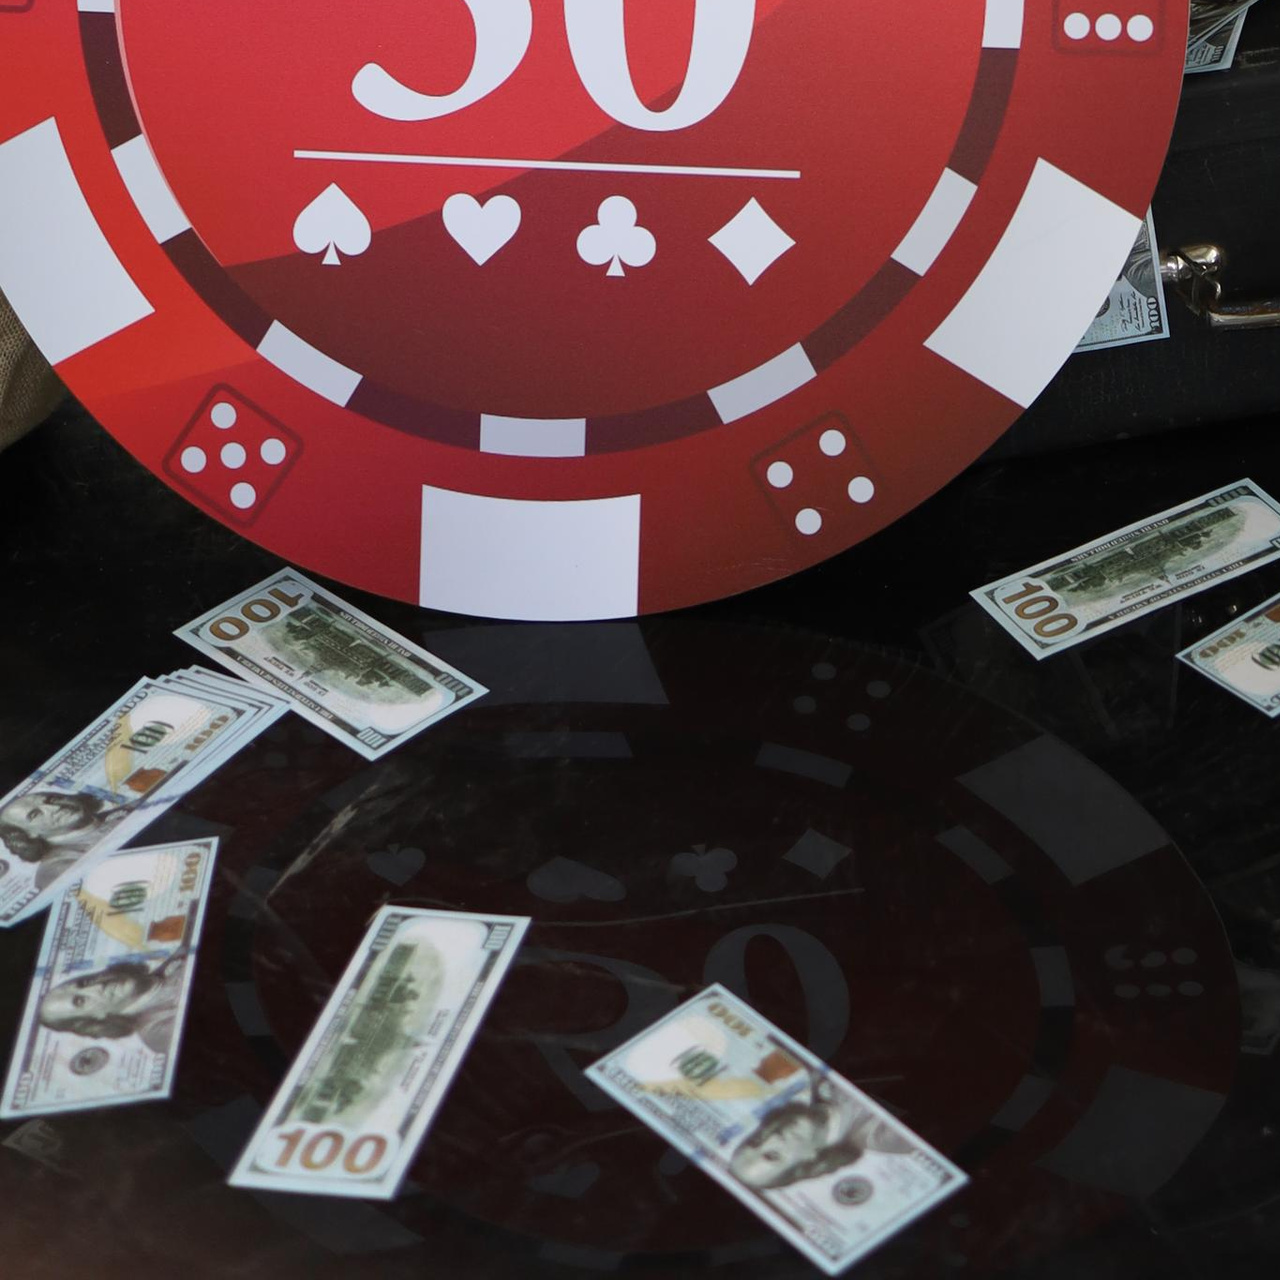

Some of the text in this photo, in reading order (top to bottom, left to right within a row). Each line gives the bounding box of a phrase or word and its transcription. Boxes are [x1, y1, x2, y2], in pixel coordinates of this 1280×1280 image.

[1148, 297, 1160, 330] 100
[208, 587, 305, 641] 100
[1001, 581, 1079, 638] 100
[355, 727, 389, 748] 100
[274, 1128, 388, 1174] 100
